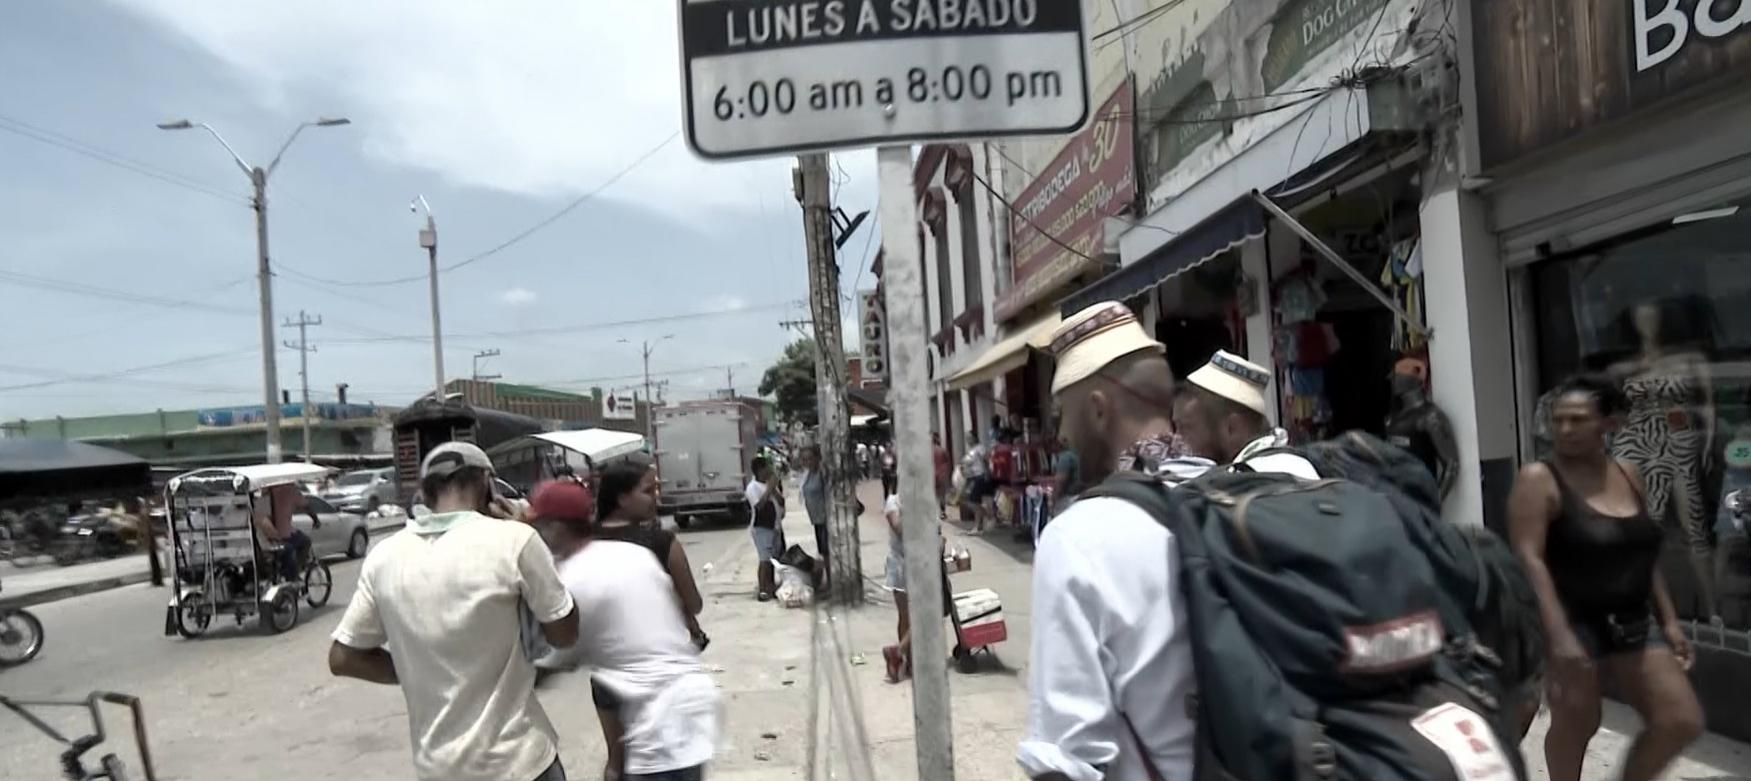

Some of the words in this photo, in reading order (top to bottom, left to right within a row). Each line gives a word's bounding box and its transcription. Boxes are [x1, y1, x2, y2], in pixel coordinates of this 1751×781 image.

[726, 2, 845, 48] LUNES
[855, 0, 881, 35] A
[889, 0, 1037, 32] SABADO
[1302, 6, 1335, 46] DOG
[713, 78, 797, 122] 6:00
[808, 78, 864, 111] am
[875, 77, 895, 105] a
[906, 63, 993, 103] 8:00
[1005, 67, 1063, 108] pm
[1088, 102, 1122, 174] 30
[863, 293, 883, 374] TAURO
